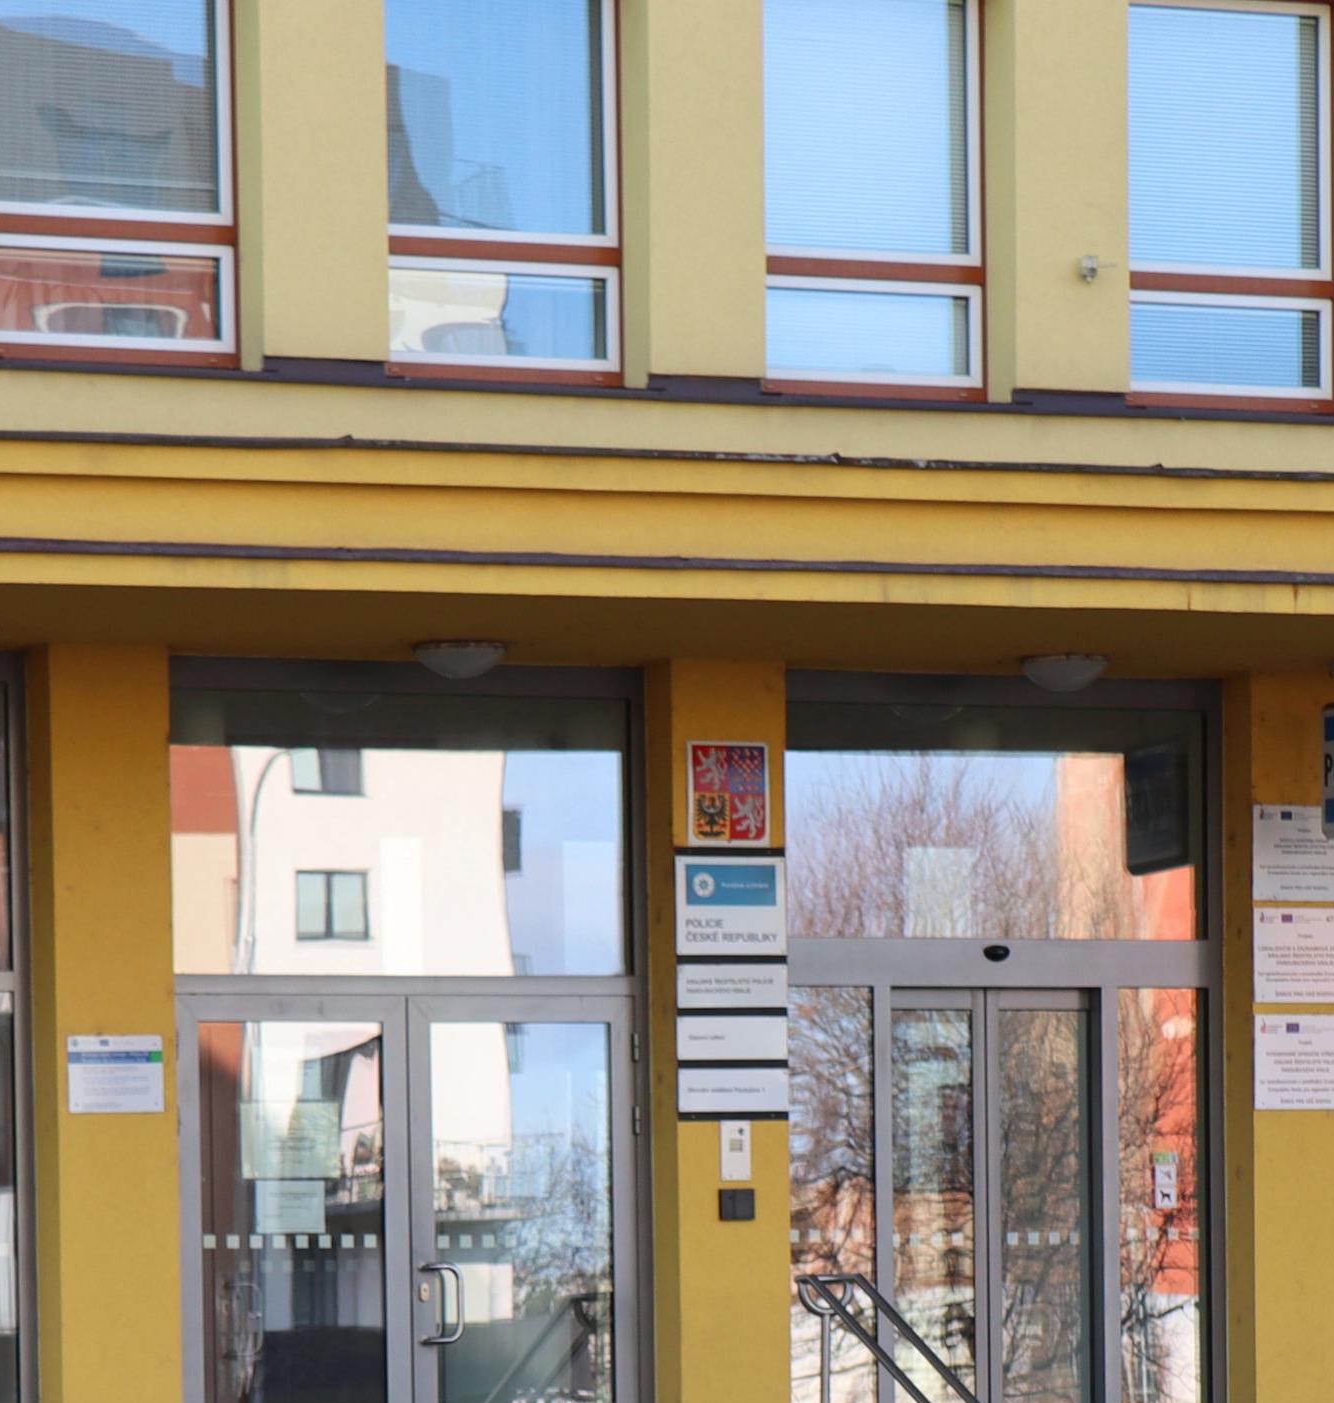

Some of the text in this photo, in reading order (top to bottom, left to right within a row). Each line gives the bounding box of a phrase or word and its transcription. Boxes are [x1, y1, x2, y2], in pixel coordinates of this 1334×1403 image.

[685, 918, 724, 929] POLICIE
[685, 930, 778, 943] ČESKÉ REPUBLIKY
